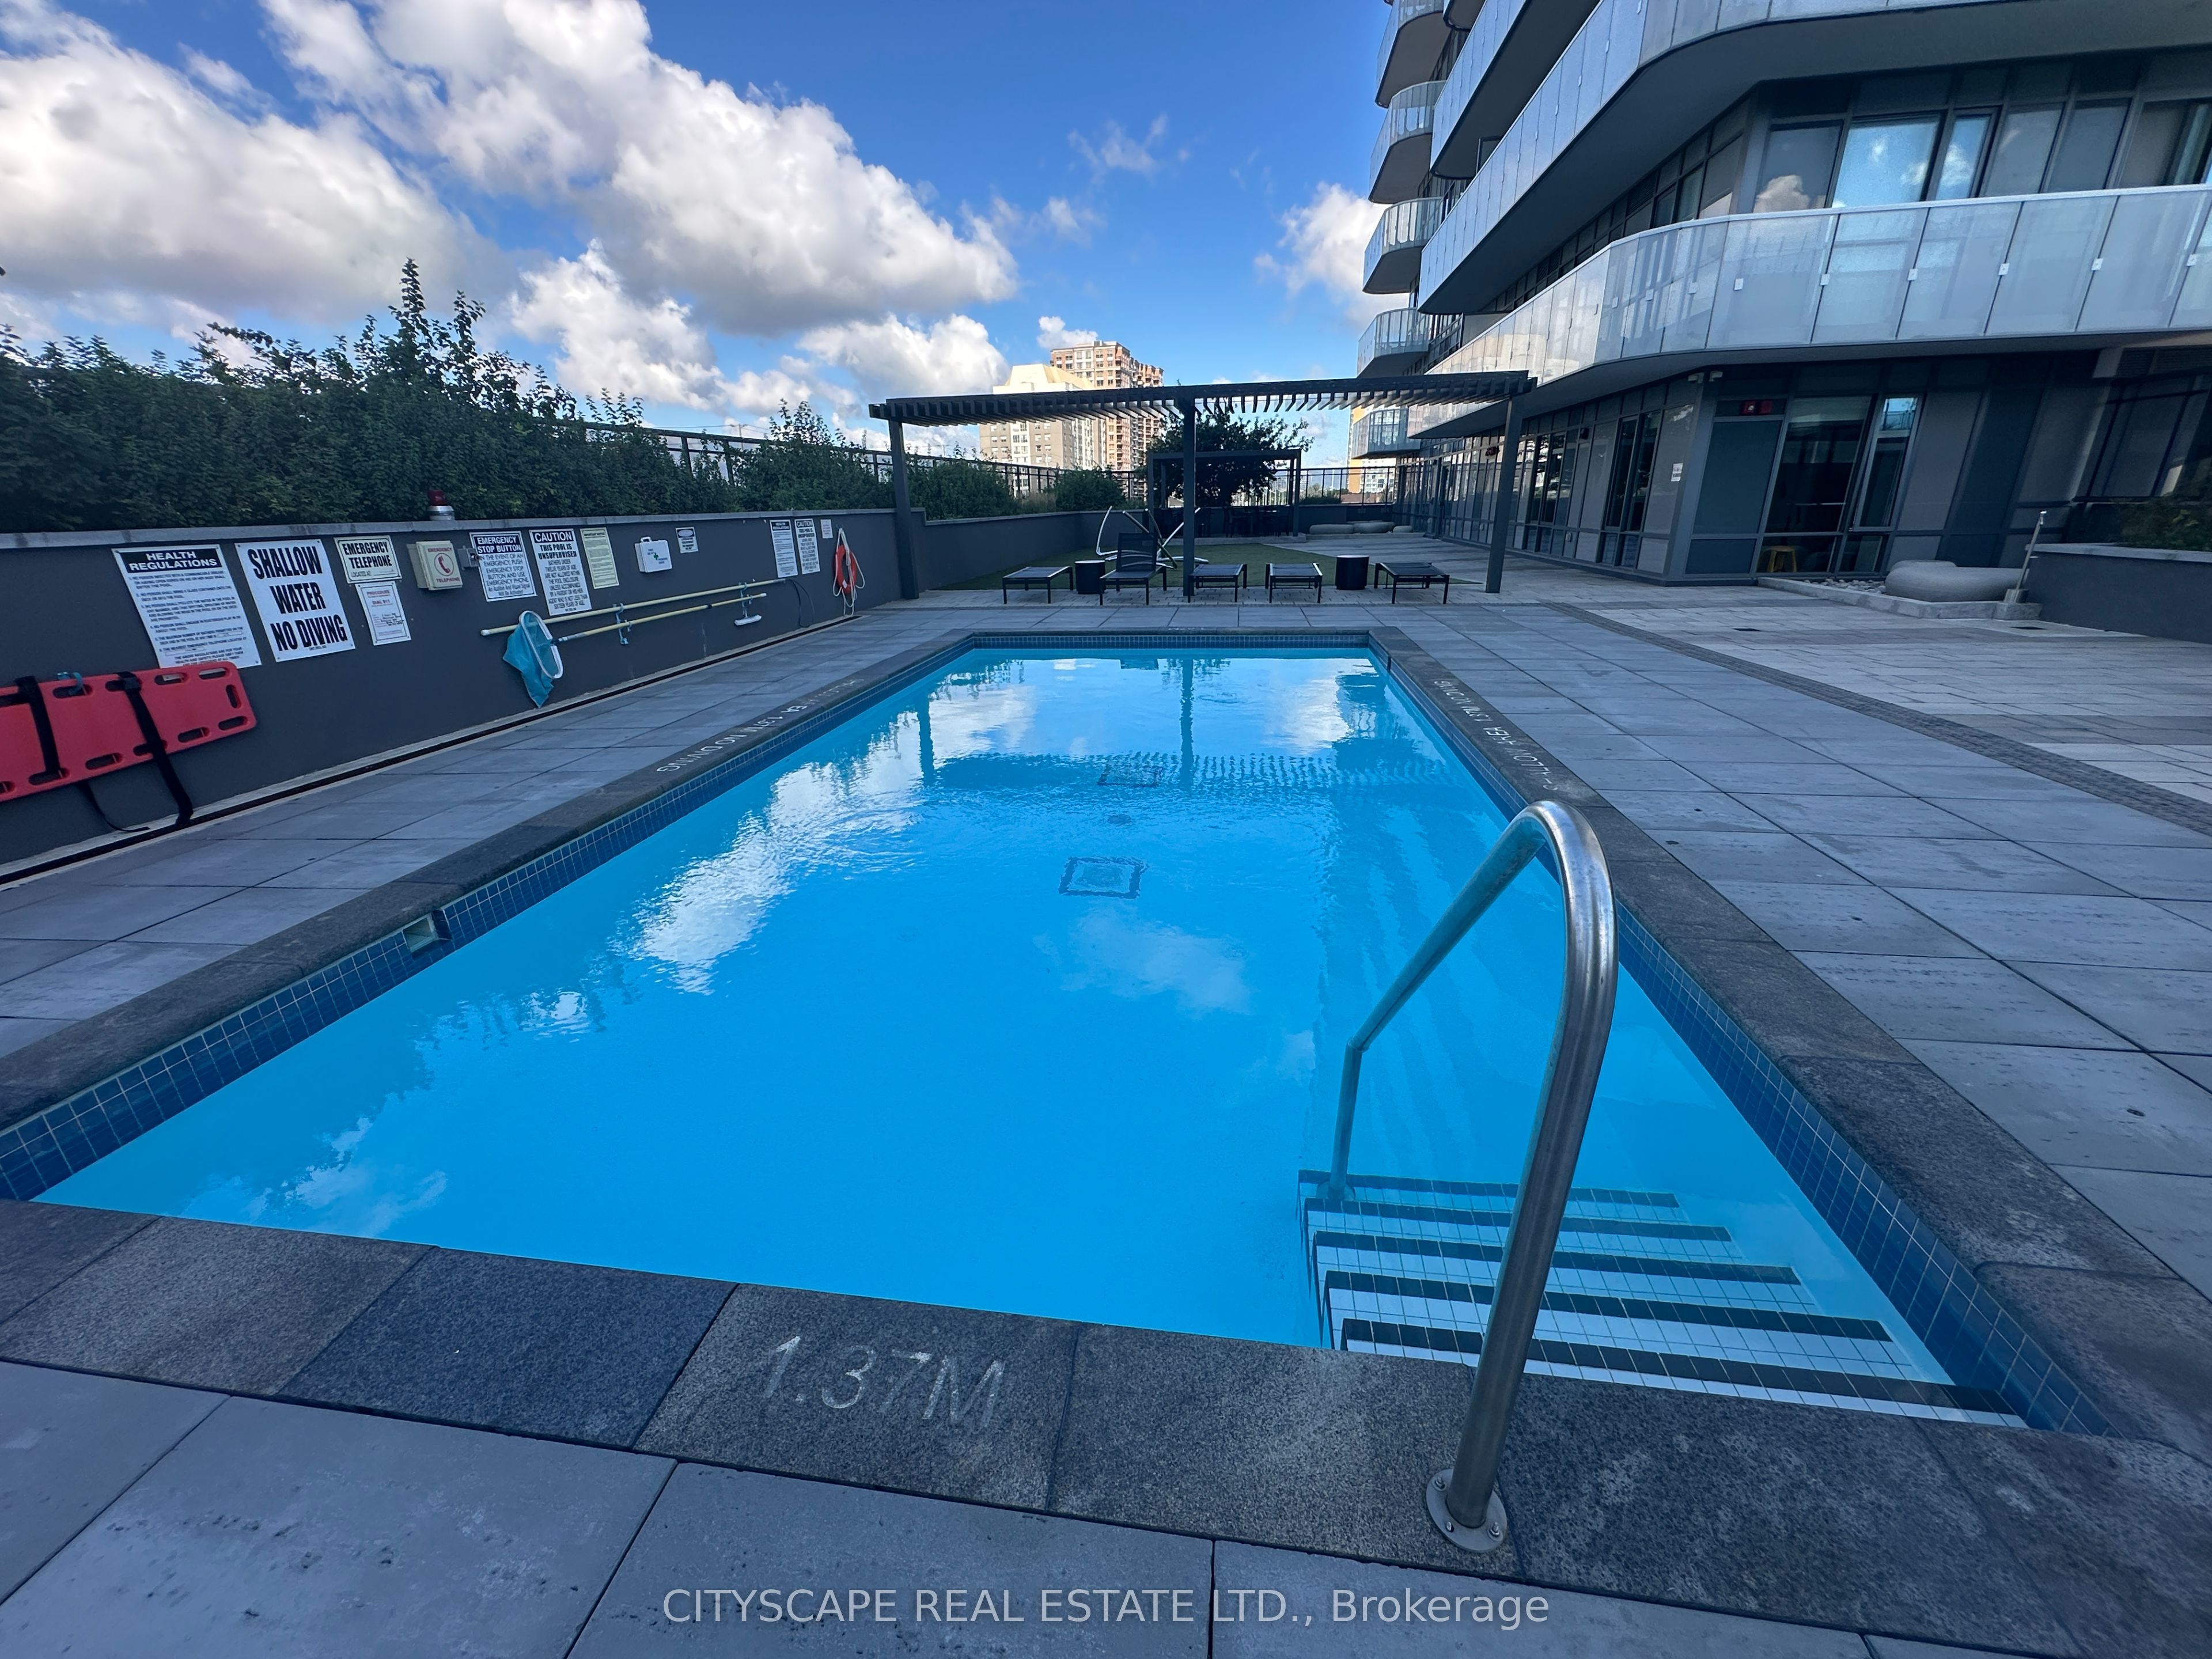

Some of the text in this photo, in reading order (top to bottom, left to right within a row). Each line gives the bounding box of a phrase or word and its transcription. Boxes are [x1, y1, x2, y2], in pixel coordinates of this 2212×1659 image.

[477, 536, 516, 544] EMERGENCY
[535, 532, 572, 542] CAUTION
[342, 541, 389, 555] EMERGENCY
[538, 550, 577, 559] UNSUPERVISED
[146, 551, 196, 560] HEALTH
[248, 546, 323, 579] SHALLOW
[349, 555, 392, 569] TELEPHONE
[128, 559, 218, 571] REGULATIONS
[270, 582, 326, 614] WATER
[270, 621, 298, 652] NO
[295, 614, 348, 647] DIVING
[715, 734, 747, 745] NO
[1483, 726, 1520, 746] AREA
[656, 745, 724, 772] DIVING
[764, 1335, 1006, 1427] 1.37M
